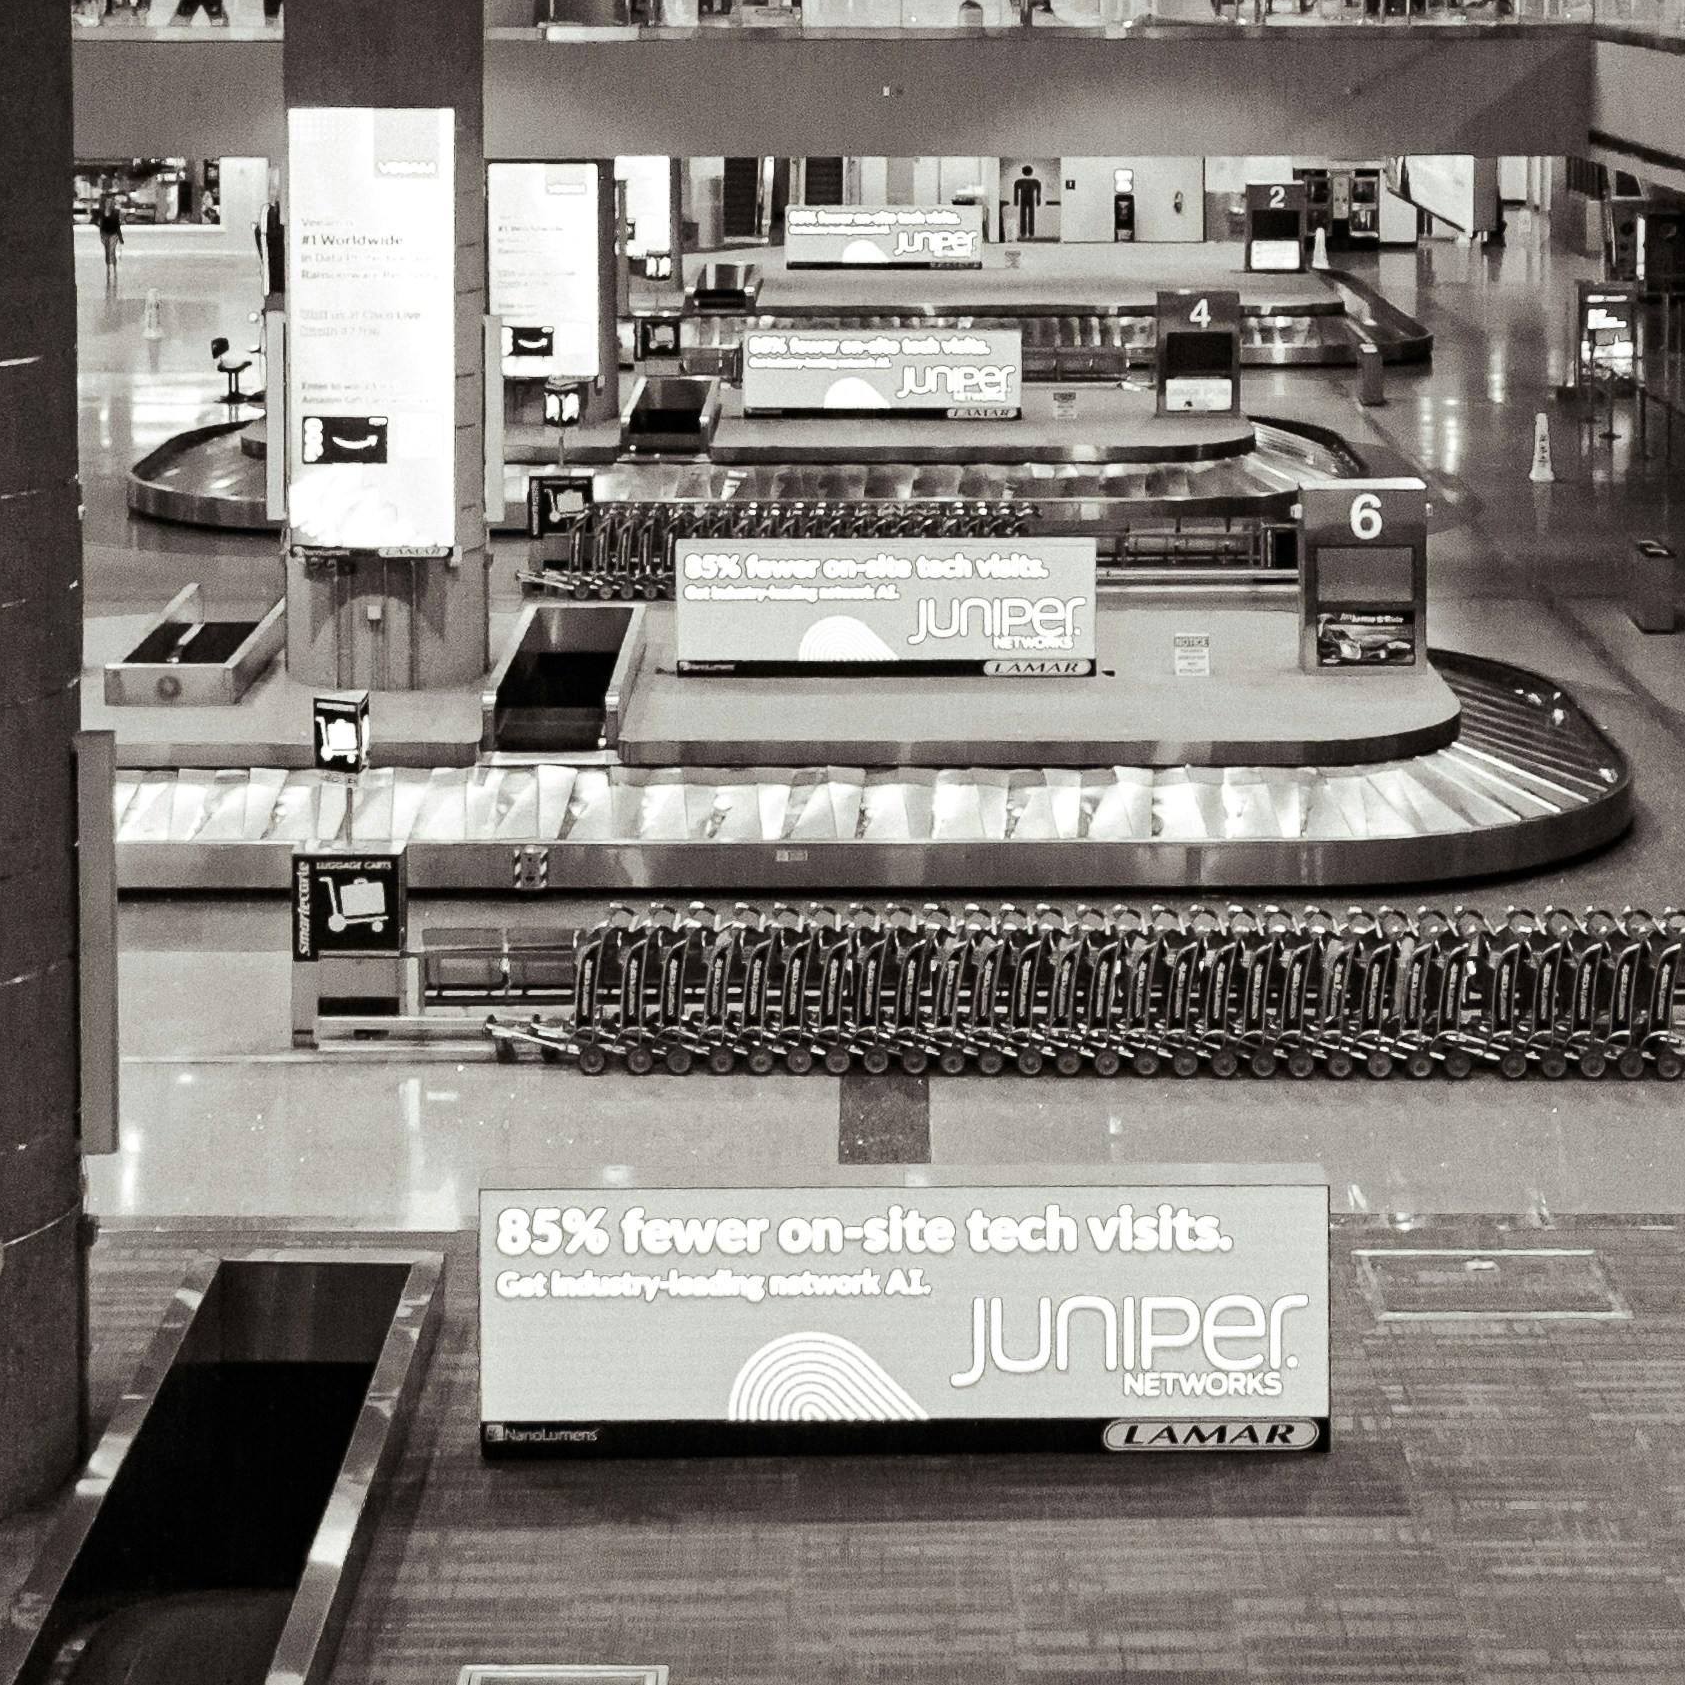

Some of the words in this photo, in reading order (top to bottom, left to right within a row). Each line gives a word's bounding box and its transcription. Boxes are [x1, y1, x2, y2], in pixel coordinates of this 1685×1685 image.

[1269, 185, 1286, 209] 2
[301, 235, 317, 246] #1
[320, 234, 404, 246] Worldwide
[1189, 298, 1212, 329] 4
[896, 365, 1016, 399] JUNIPER
[1349, 493, 1383, 540] 6
[916, 552, 974, 579] tech
[907, 596, 1088, 645] JUNIPER
[992, 661, 1080, 675] LAMAR
[495, 1206, 610, 1257] 85%
[620, 1205, 765, 1254] fewer
[776, 1205, 956, 1254] on-site
[967, 1204, 1079, 1253] tech
[1089, 1203, 1234, 1253] visits.
[496, 1269, 547, 1299] Get
[549, 1268, 766, 1302] industry-leading
[768, 1268, 882, 1297] network
[949, 1293, 1311, 1389] JUNIPER
[1122, 1371, 1284, 1398] NETWORKS
[505, 1427, 600, 1442] NanoLumens
[1120, 1423, 1297, 1447] LAMAR
